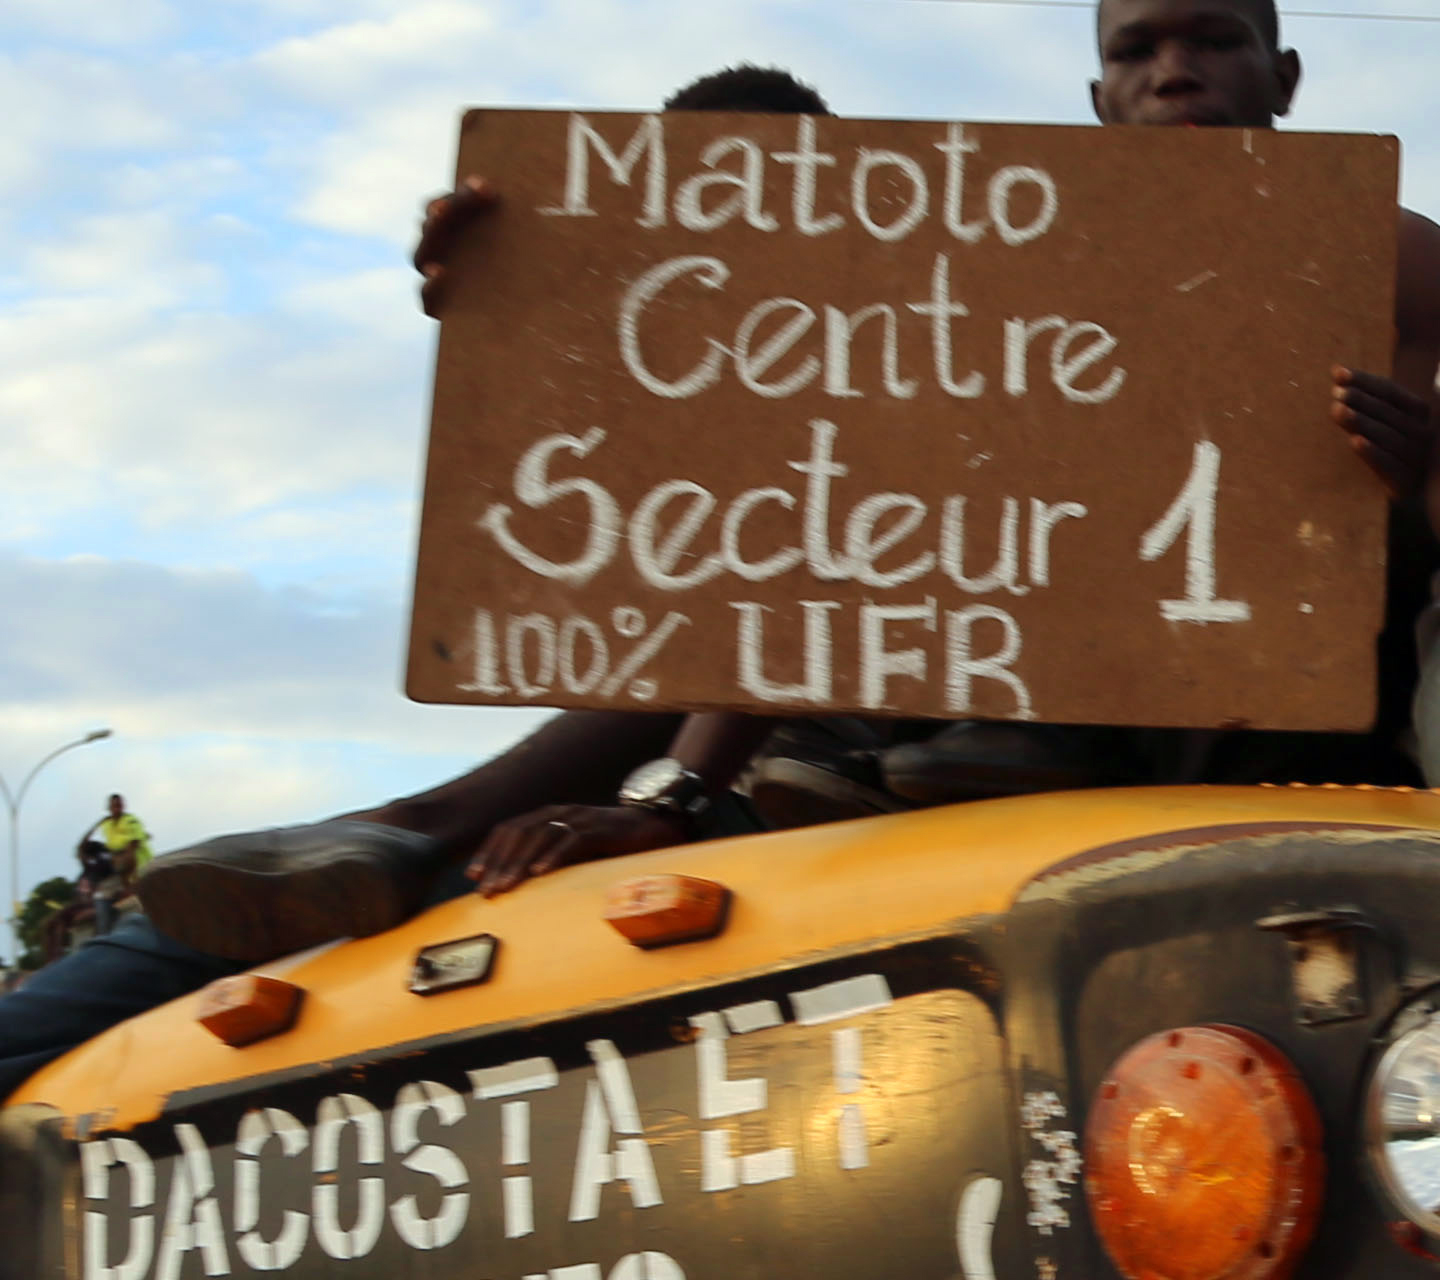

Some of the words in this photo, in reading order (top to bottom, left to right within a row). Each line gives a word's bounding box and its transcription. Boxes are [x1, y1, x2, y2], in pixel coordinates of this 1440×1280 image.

[534, 113, 1058, 245] Matoto
[619, 252, 1126, 403] Centre
[480, 418, 1087, 595] Secteur
[1138, 439, 1250, 625] 1
[456, 604, 690, 702] 100%
[728, 592, 1039, 721] UFR
[691, 974, 893, 1193] ET
